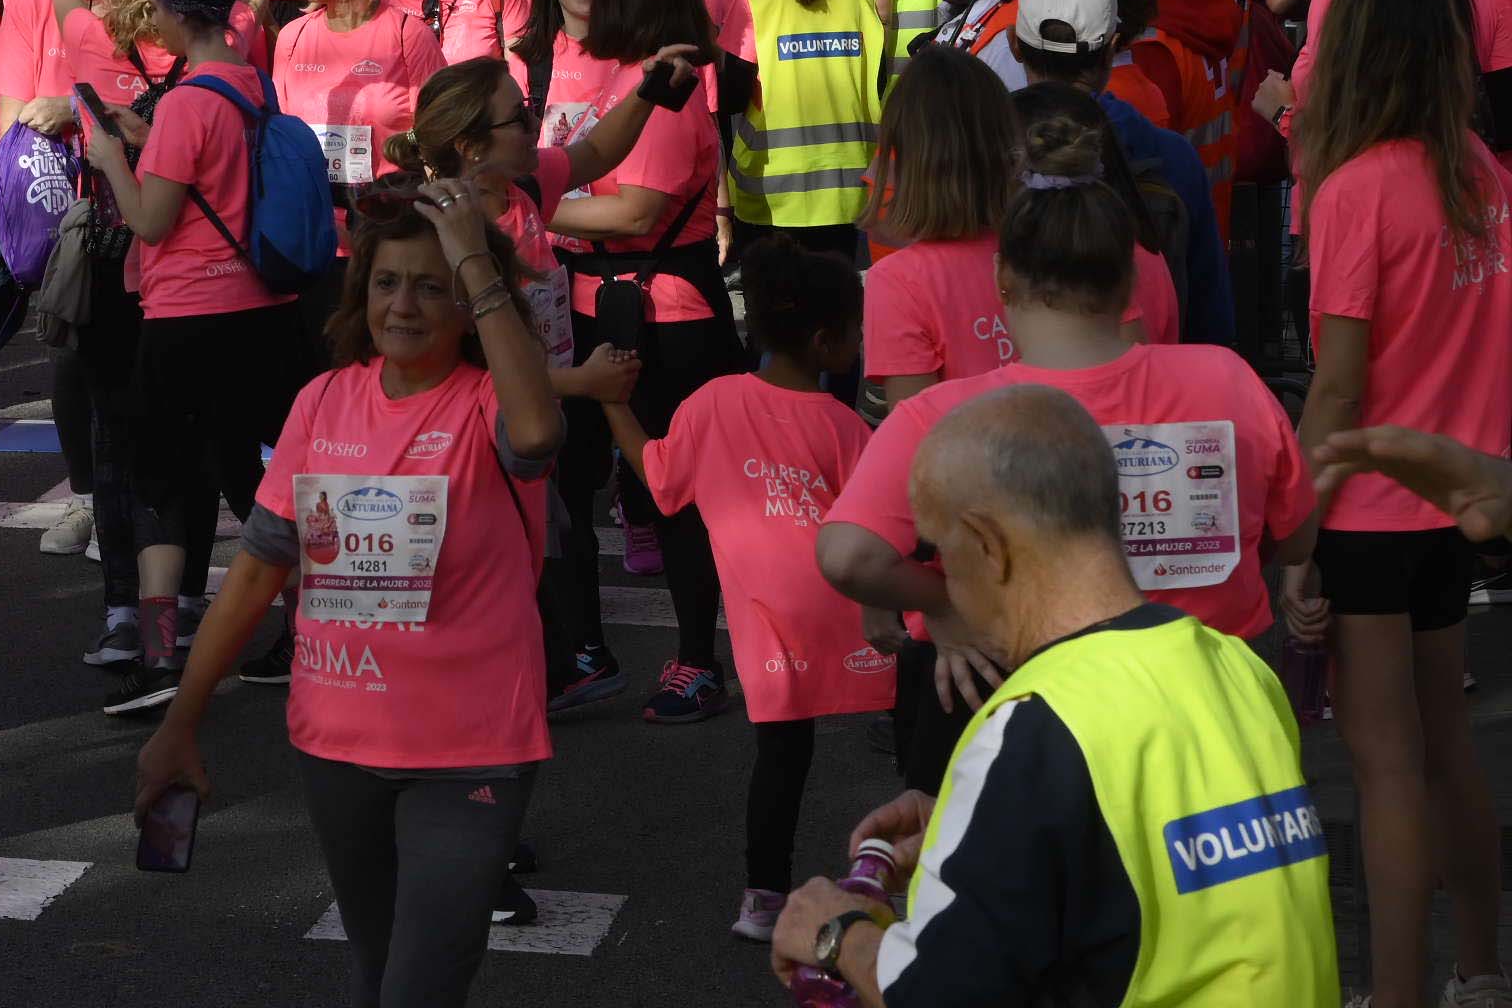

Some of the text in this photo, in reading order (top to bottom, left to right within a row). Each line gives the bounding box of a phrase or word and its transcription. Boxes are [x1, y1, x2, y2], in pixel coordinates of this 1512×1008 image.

[779, 37, 861, 55] VOLUNTARIS
[312, 438, 368, 458] OYSHO
[1185, 445, 1221, 455] SUMA
[1117, 456, 1173, 467] STURIANA
[341, 498, 399, 514] ASTURIANA
[408, 494, 437, 505] SUMA
[344, 532, 395, 554] 016
[1139, 543, 1154, 553] LA
[1155, 542, 1192, 552] MUJER
[1195, 541, 1221, 550] 2023
[350, 560, 388, 573] 14281
[1168, 563, 1227, 576] Santander
[314, 578, 351, 589] CARRERA
[352, 578, 365, 588] DE
[366, 579, 378, 588] LA
[380, 579, 409, 589] MUJER
[310, 597, 354, 609] OYSHO
[294, 634, 384, 679] SUMA
